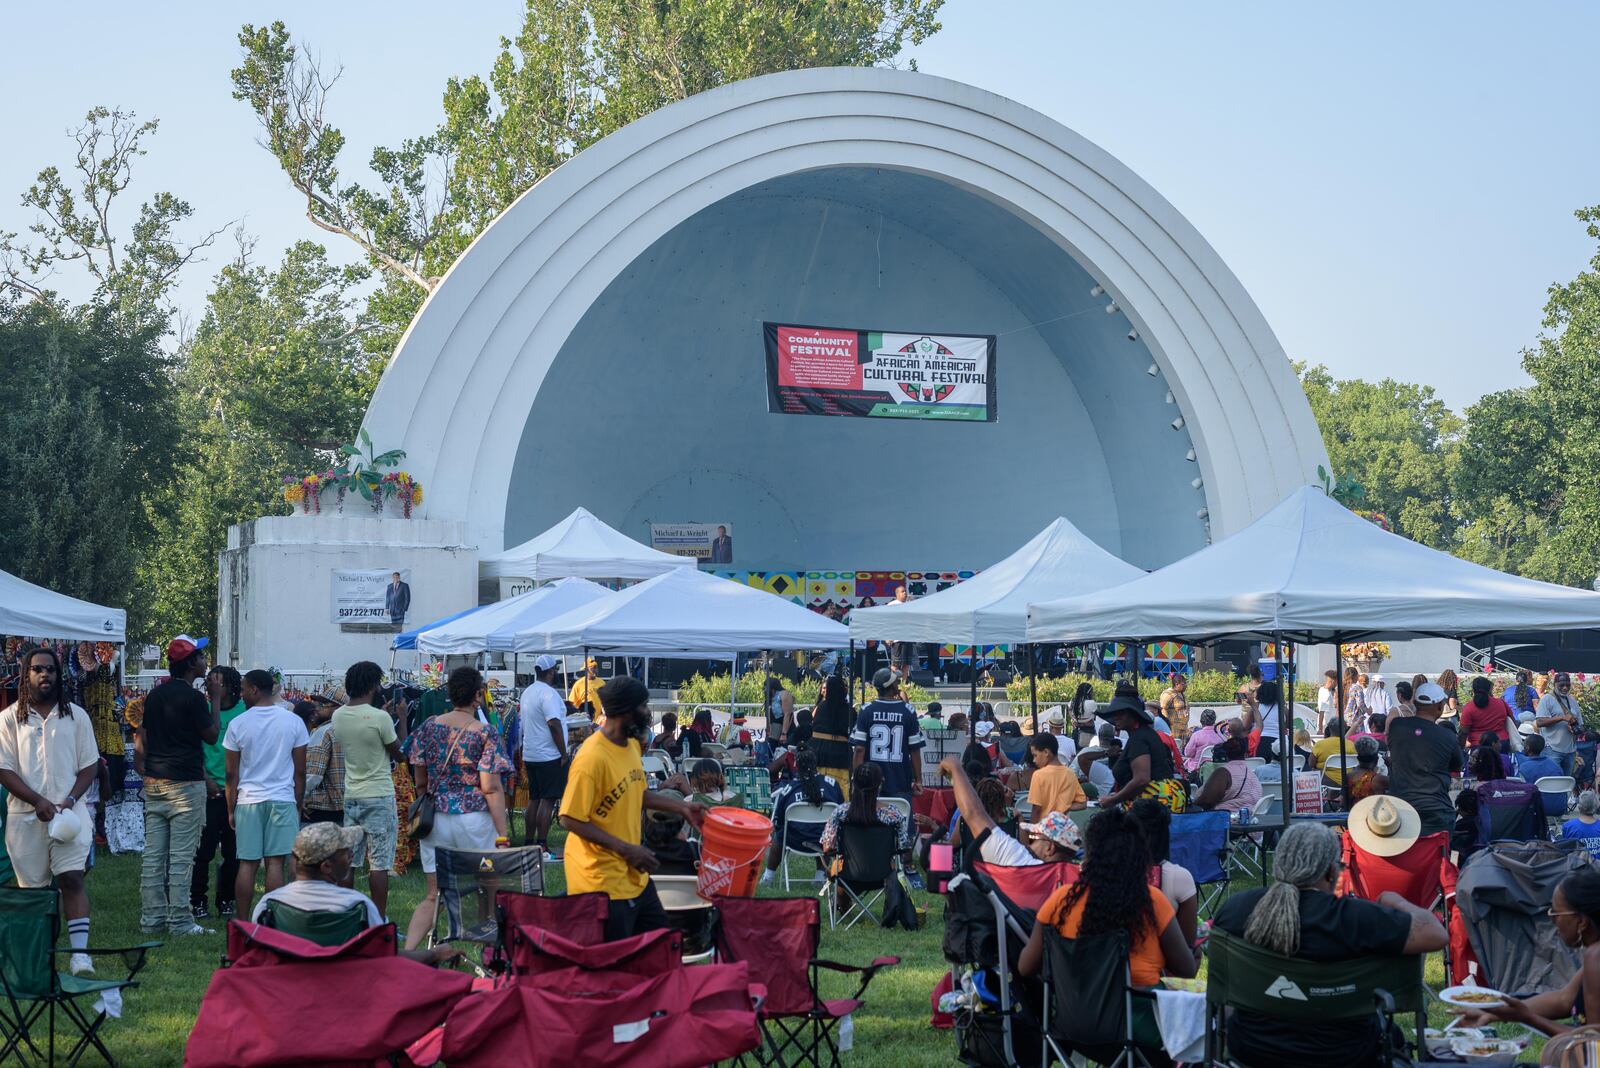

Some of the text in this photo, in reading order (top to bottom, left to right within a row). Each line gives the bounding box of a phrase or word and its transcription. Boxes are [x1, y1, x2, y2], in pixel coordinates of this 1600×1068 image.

[788, 336, 853, 346] COMMUNITY
[790, 346, 851, 357] FESTIVAL
[876, 358, 976, 372] AFRICAN AMERICAN
[864, 368, 927, 382] CULTURAL
[931, 372, 987, 384] FESTIVAL
[339, 608, 384, 617] 937.222.7477
[873, 711, 903, 722] ELLIOTT
[870, 724, 904, 763] 21
[596, 777, 628, 818] STREET
[704, 876, 730, 896] DEPOT
